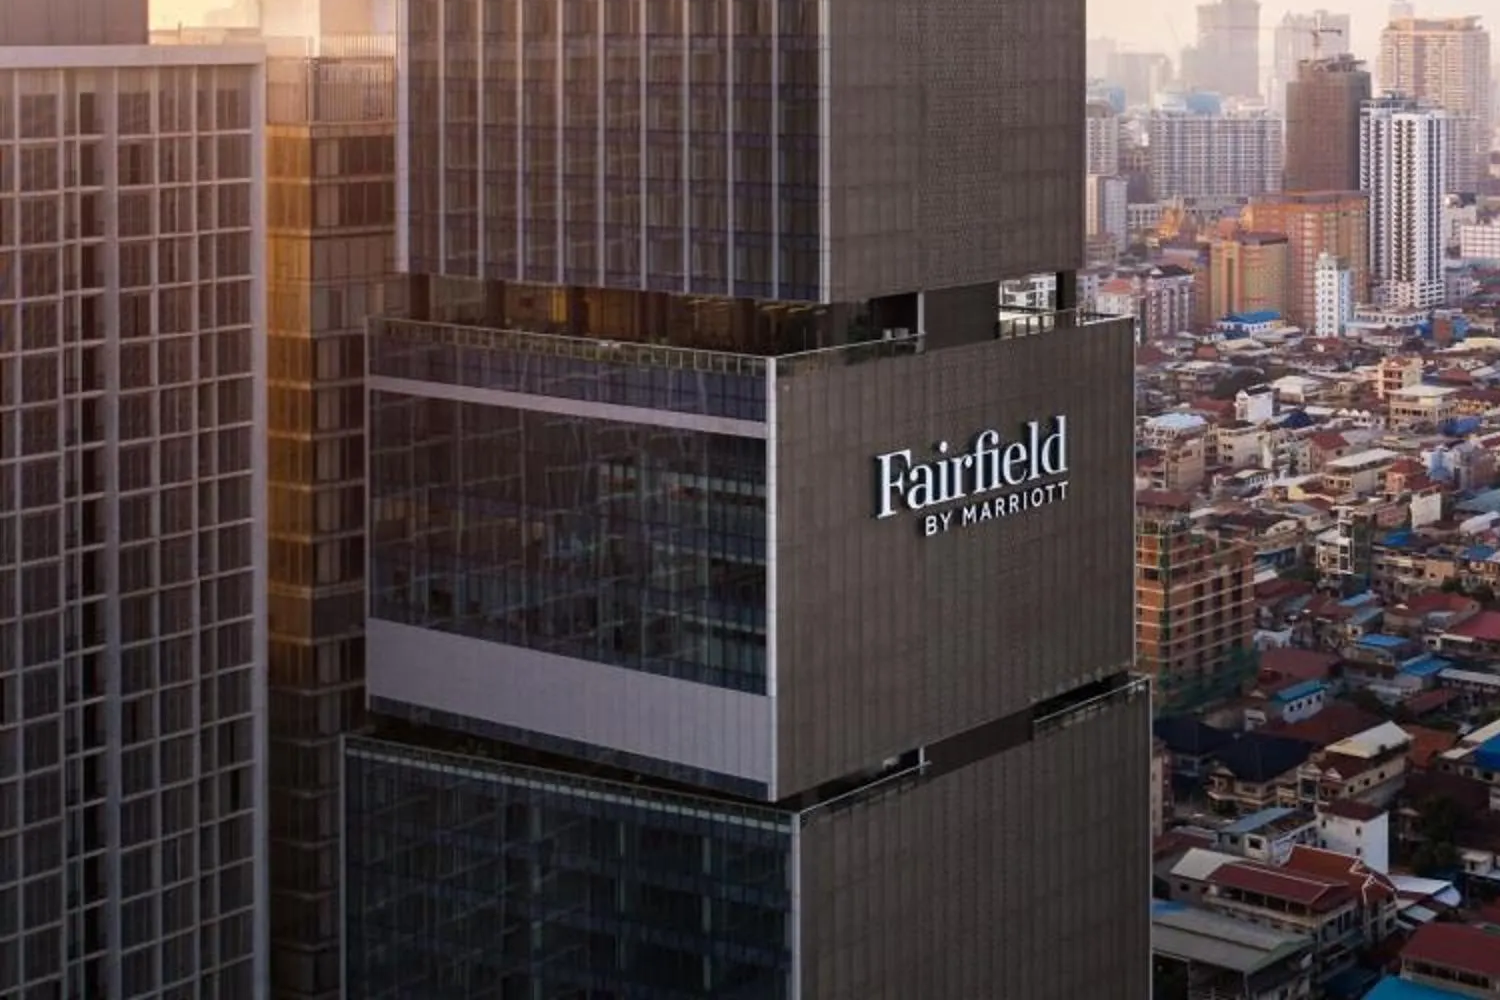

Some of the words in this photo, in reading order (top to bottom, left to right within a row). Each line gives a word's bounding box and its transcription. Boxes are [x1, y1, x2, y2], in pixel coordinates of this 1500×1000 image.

[876, 415, 1068, 519] Fairfield
[925, 511, 953, 537] BY
[962, 481, 1069, 528] MARRIOTT
